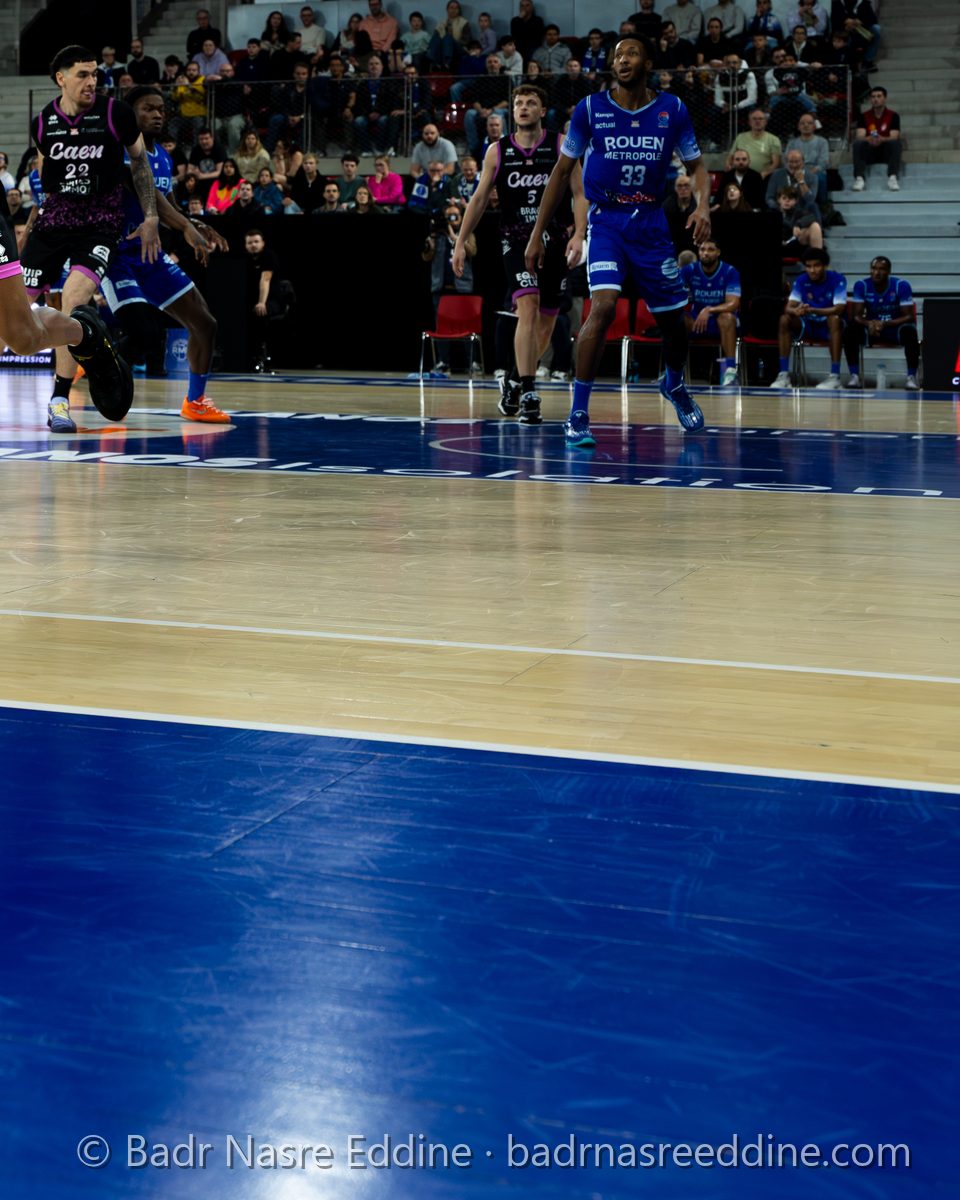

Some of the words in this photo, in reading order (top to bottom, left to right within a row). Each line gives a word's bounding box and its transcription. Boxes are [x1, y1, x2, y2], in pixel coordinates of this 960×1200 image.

[50, 142, 105, 161] Caen
[604, 136, 665, 152] ROUEN
[65, 163, 90, 180] 22
[620, 165, 647, 187] 33
[527, 189, 538, 204] 5
[24, 266, 43, 278] UIP
[269, 459, 945, 497] Isolation
